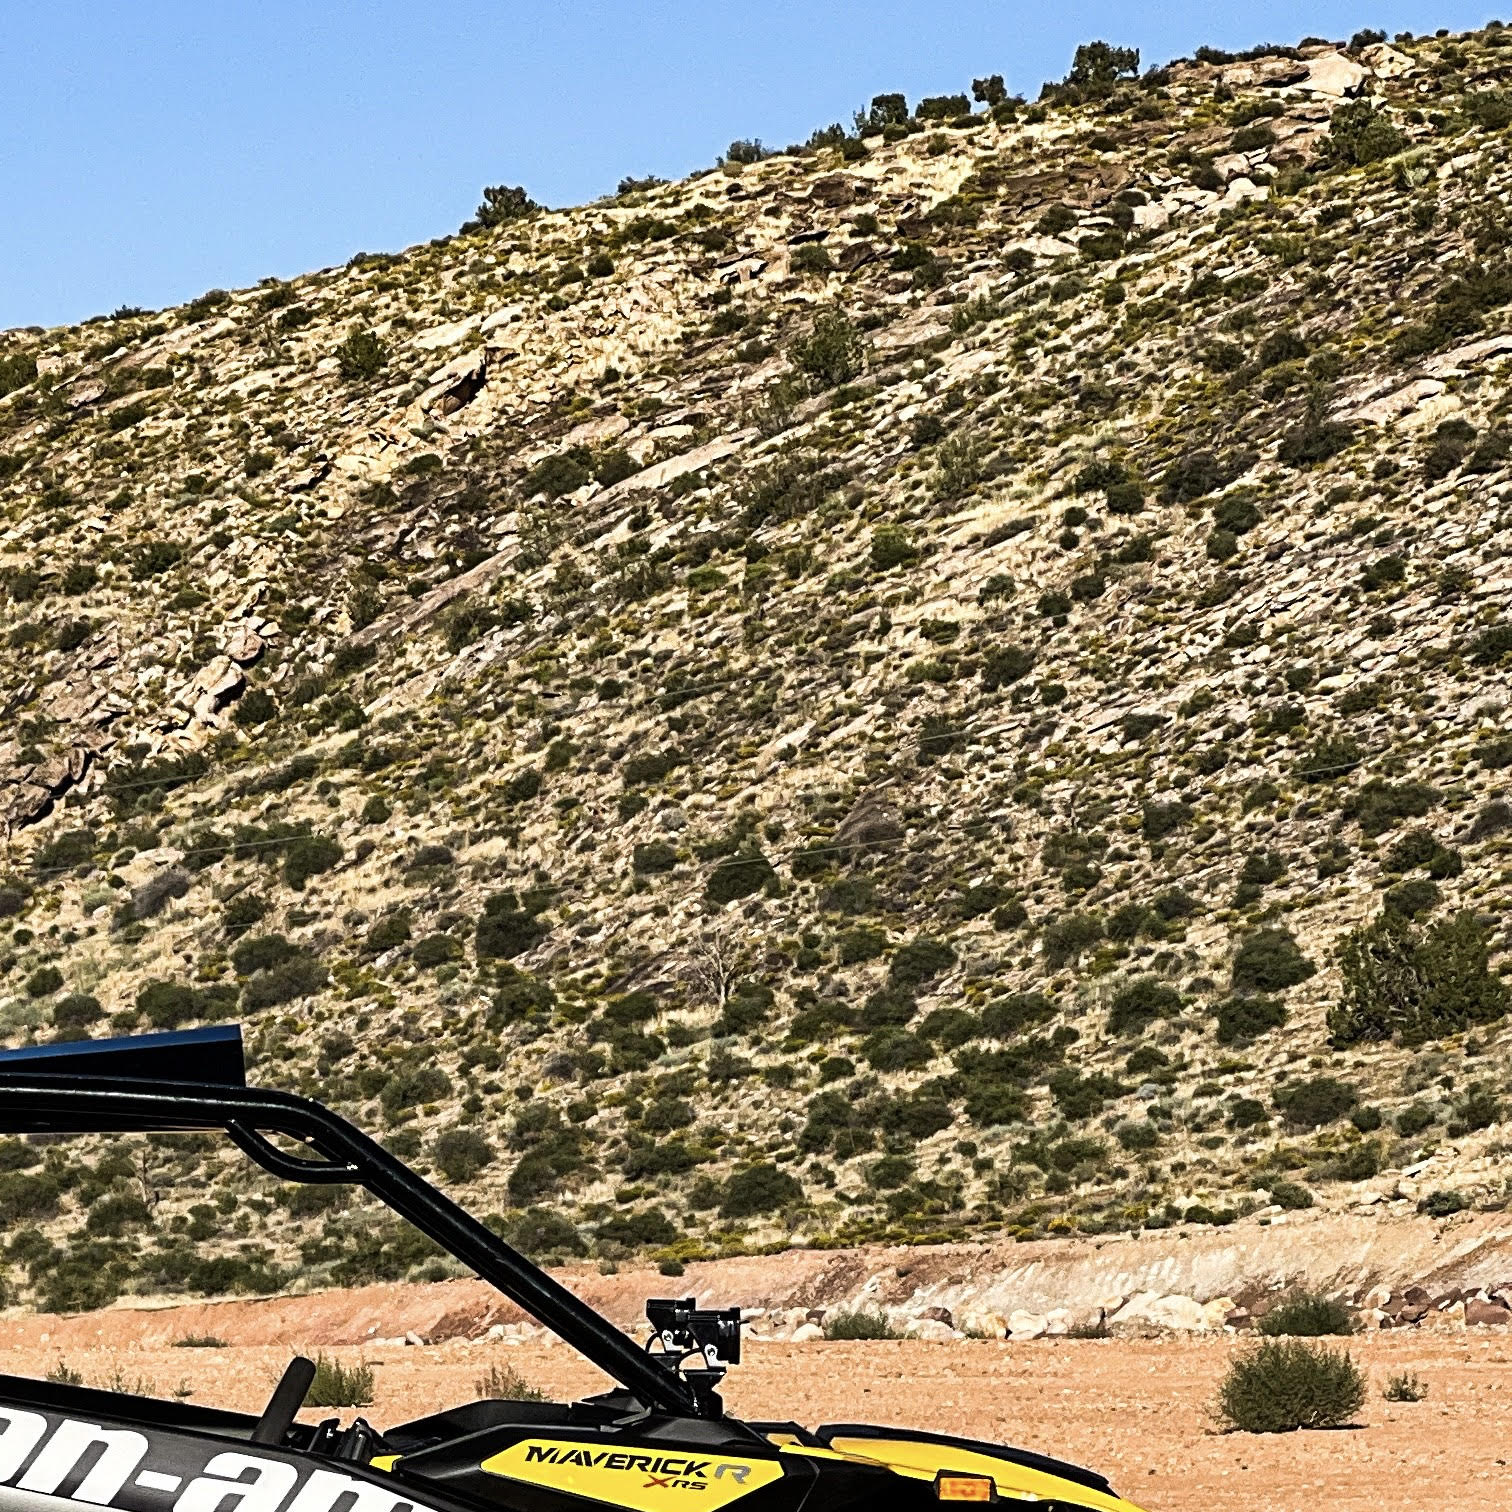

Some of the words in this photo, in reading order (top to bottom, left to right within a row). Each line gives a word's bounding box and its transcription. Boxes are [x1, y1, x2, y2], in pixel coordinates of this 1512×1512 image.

[524, 1446, 712, 1478] MAVERICK
[714, 1463, 752, 1485] R
[642, 1474, 709, 1492] XRS
